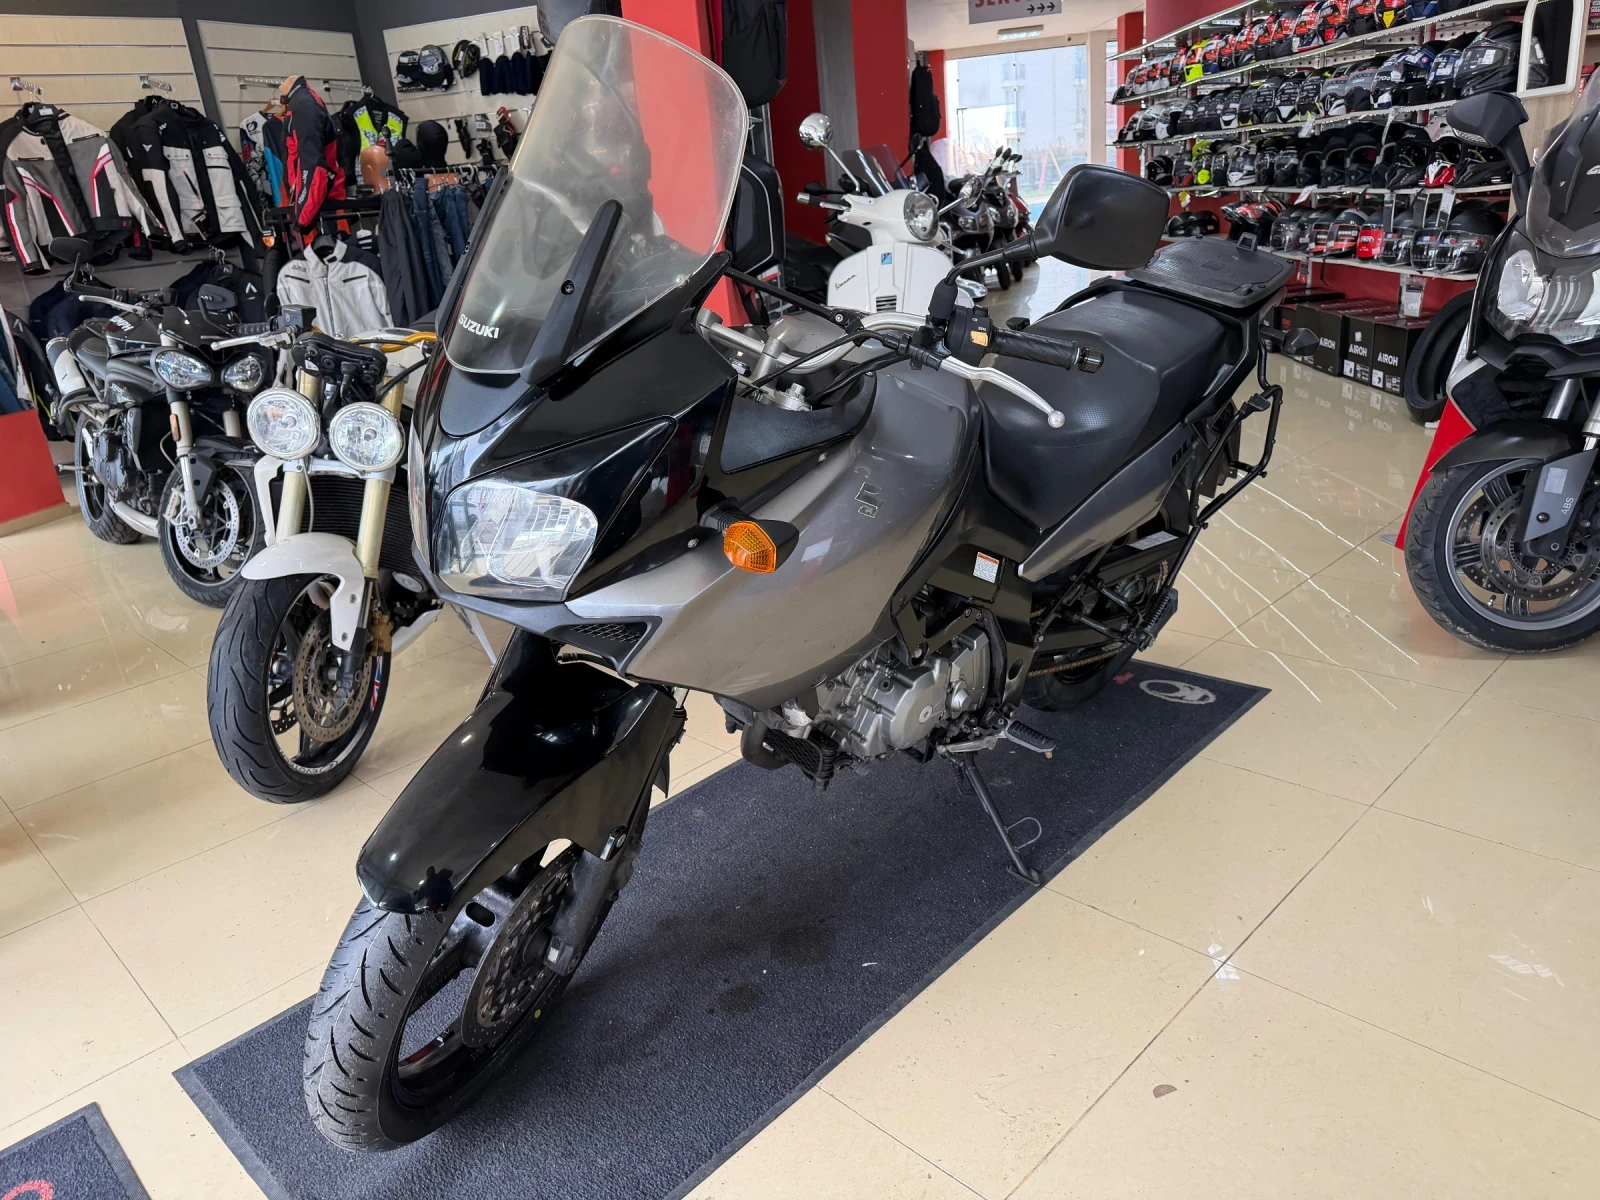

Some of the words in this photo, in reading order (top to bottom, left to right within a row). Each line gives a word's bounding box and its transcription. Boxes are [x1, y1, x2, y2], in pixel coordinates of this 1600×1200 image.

[458, 313, 499, 339] SUZUKI
[1319, 337, 1336, 350] AIROH
[1349, 343, 1368, 357] AIROH
[1377, 352, 1399, 367] AIROH
[1560, 496, 1574, 516] ABS
